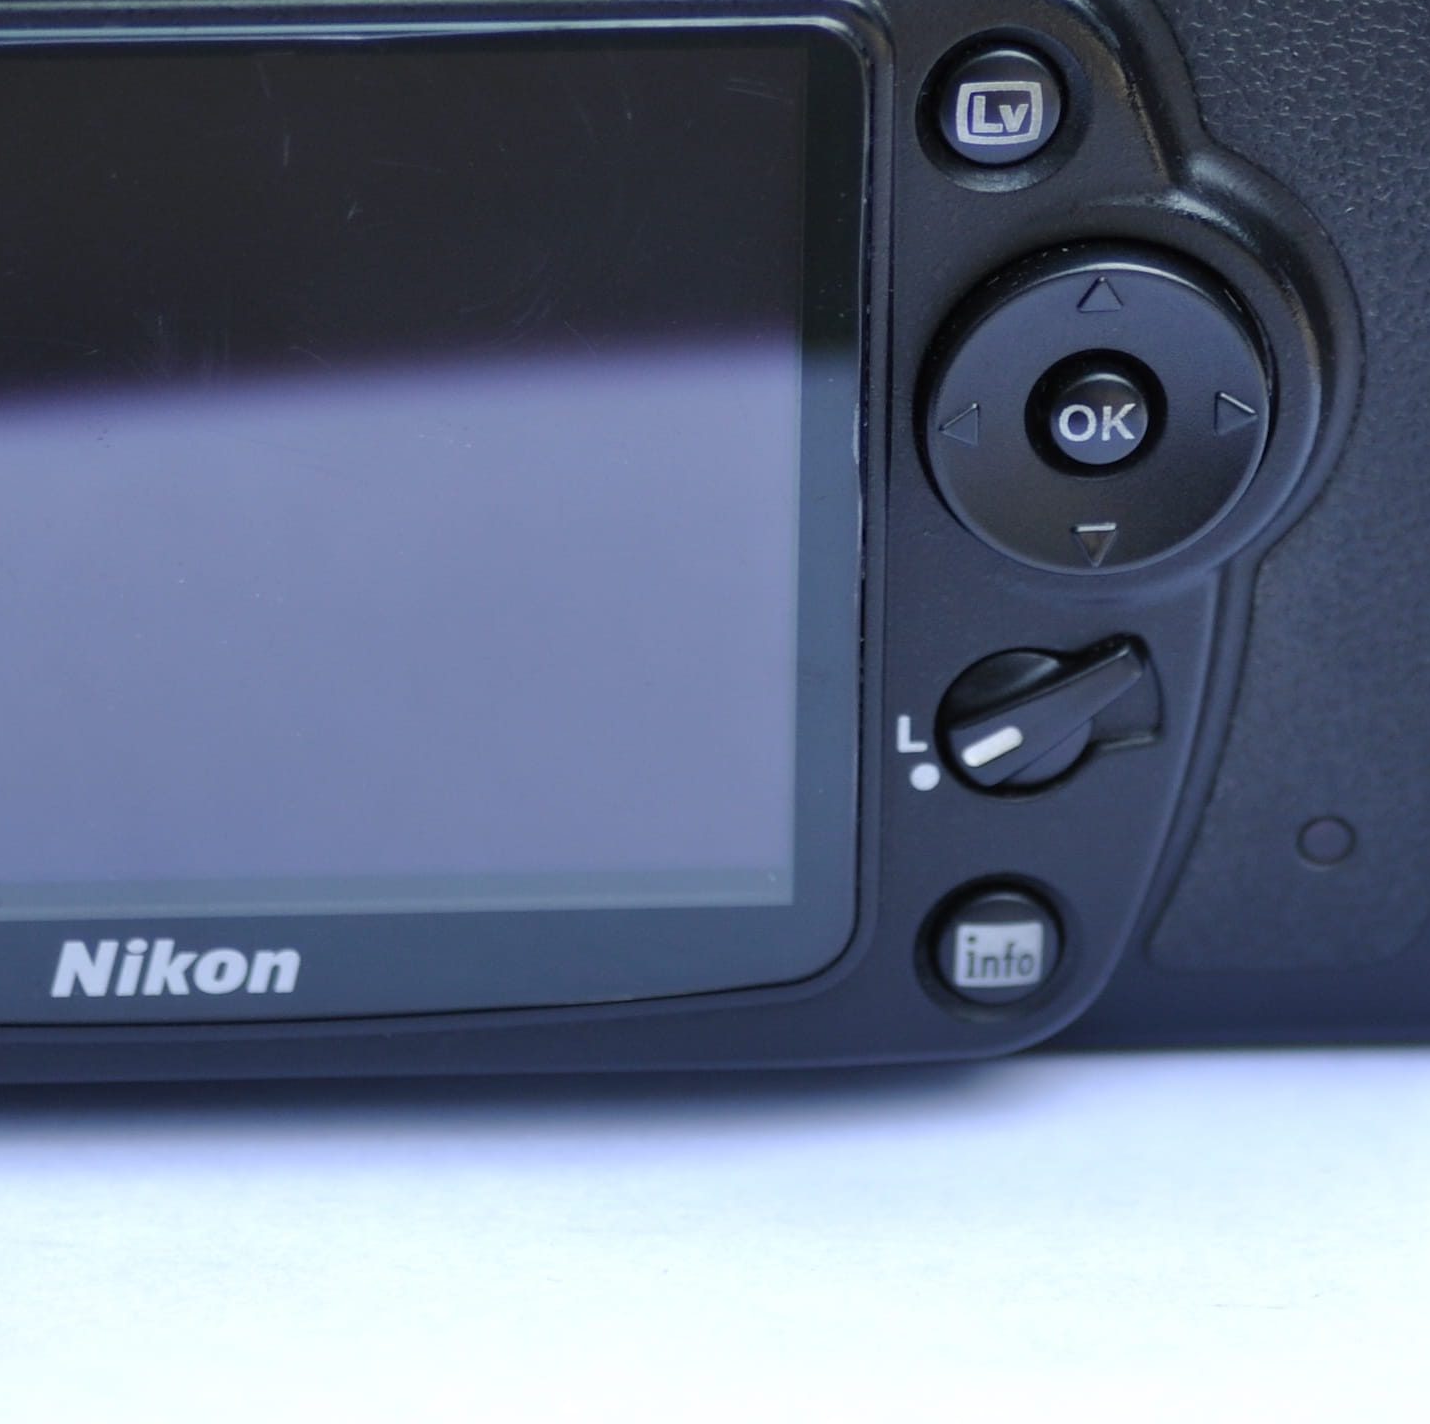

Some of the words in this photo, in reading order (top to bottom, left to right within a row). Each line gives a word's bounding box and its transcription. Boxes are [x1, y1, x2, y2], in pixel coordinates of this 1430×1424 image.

[971, 95, 1030, 134] Lv
[1058, 403, 1137, 442] OK
[896, 715, 929, 753] L
[50, 938, 302, 998] Nikon
[965, 936, 1036, 980] info
